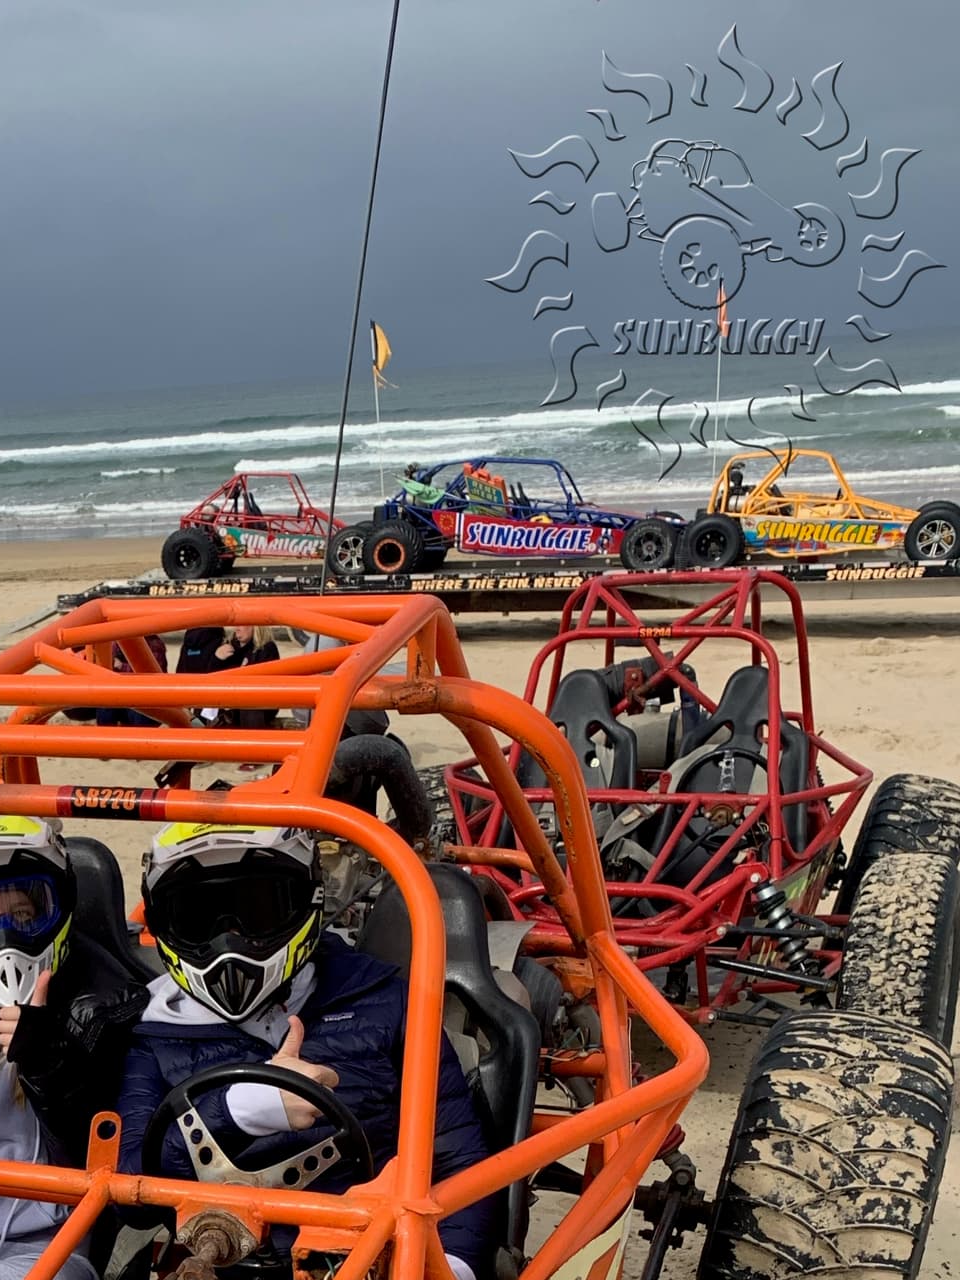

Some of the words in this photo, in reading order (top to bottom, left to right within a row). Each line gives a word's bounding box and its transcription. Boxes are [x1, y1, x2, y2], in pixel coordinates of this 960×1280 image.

[466, 522, 593, 551] SUNBUGGIE
[756, 520, 880, 544] SUNBUGGIE
[411, 579, 463, 590] WHERE
[468, 579, 496, 590] THE
[499, 578, 530, 589] FUN
[533, 577, 583, 588] NEVER
[825, 567, 926, 581] SUNBUGGIE
[73, 788, 137, 811] SB220
